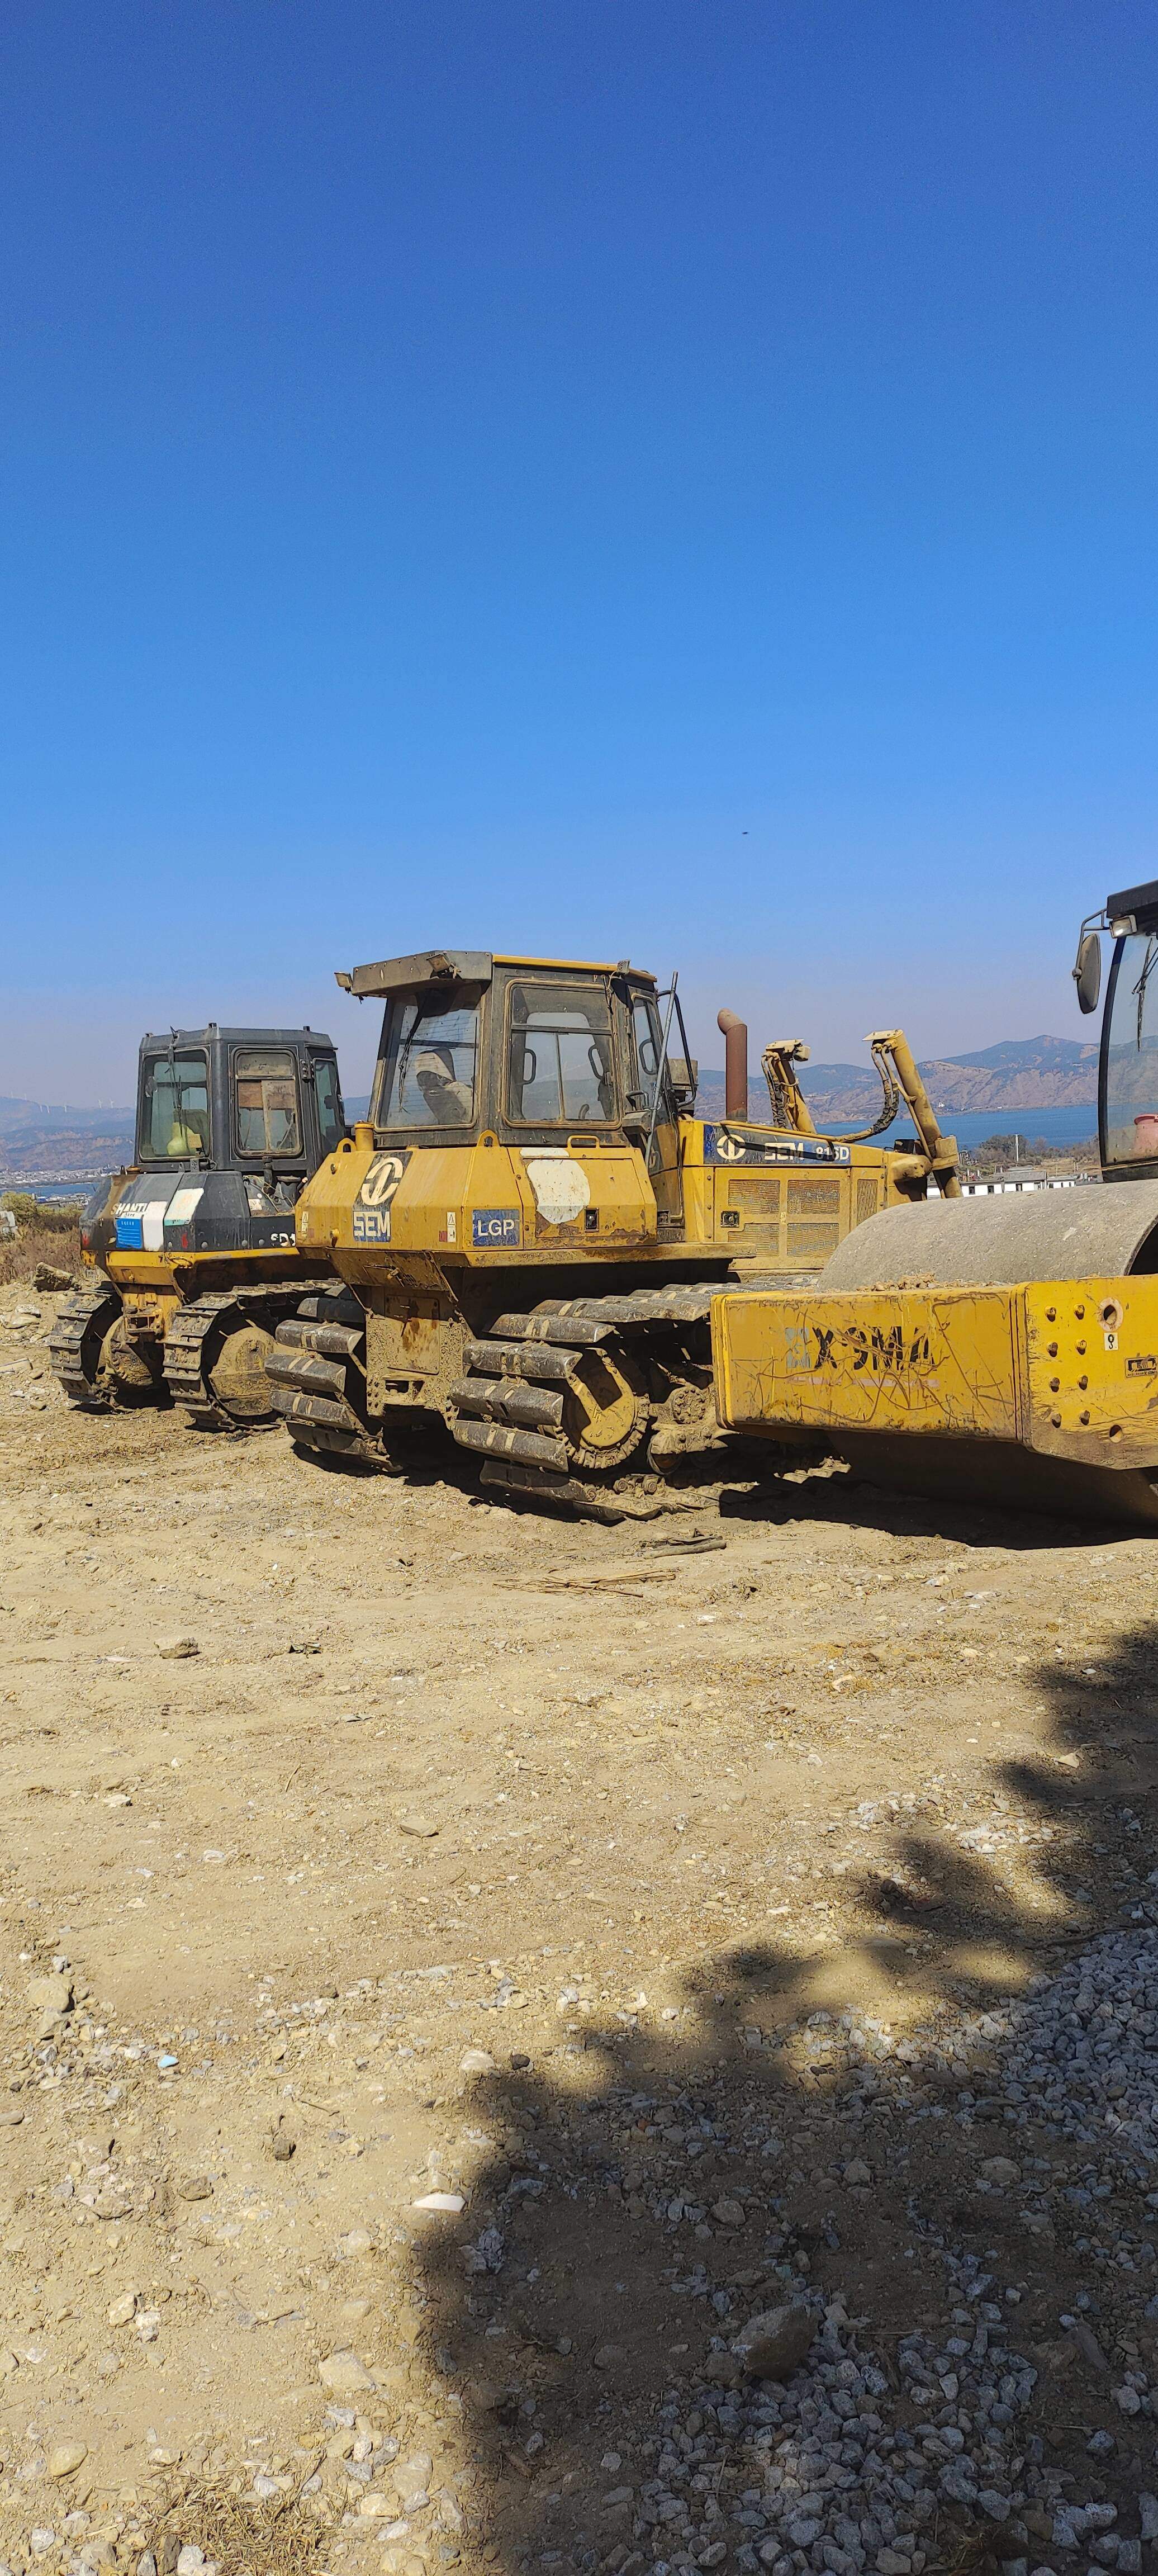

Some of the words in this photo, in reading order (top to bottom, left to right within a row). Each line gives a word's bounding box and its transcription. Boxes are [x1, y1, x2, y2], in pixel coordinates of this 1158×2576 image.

[765, 1142, 804, 1161] SEM
[353, 1211, 391, 1237] SEM
[478, 1219, 515, 1237] LGP
